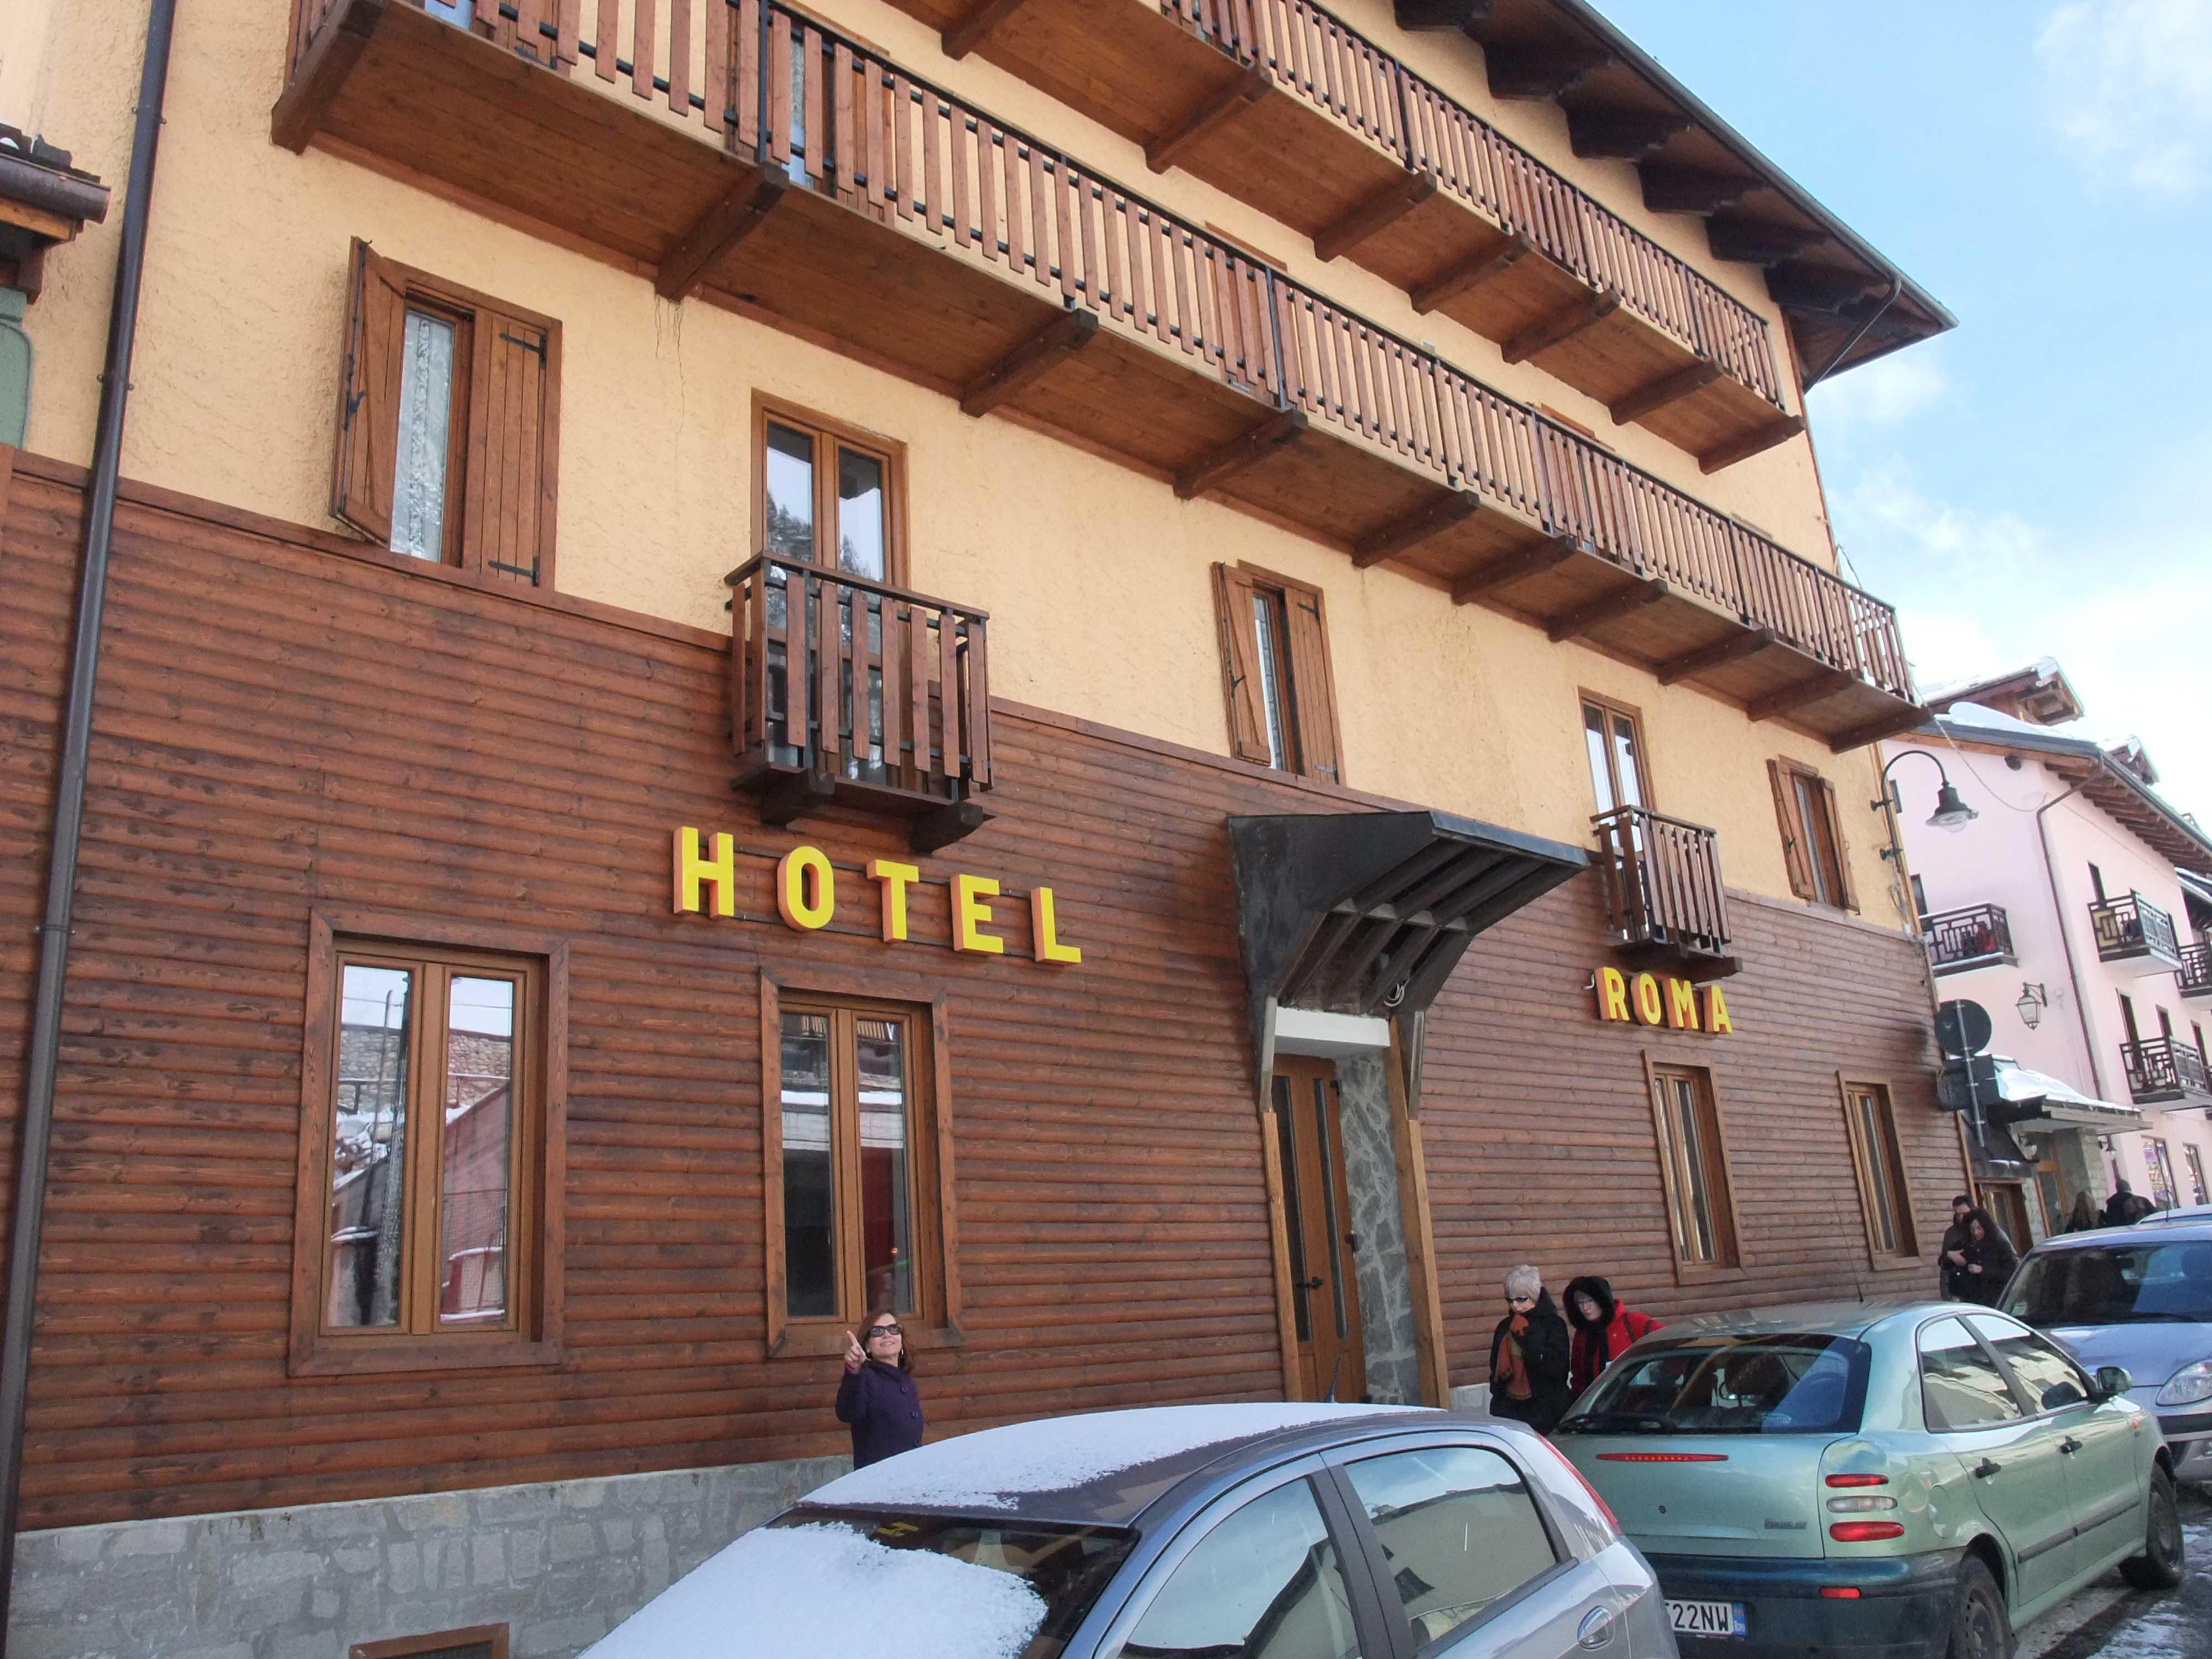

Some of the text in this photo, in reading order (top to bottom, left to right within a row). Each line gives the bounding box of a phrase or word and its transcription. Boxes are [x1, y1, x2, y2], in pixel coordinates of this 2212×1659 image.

[672, 826, 1082, 964] HOTEL
[1595, 966, 1733, 1034] ROMA
[1665, 1602, 1729, 1632] 22NW
